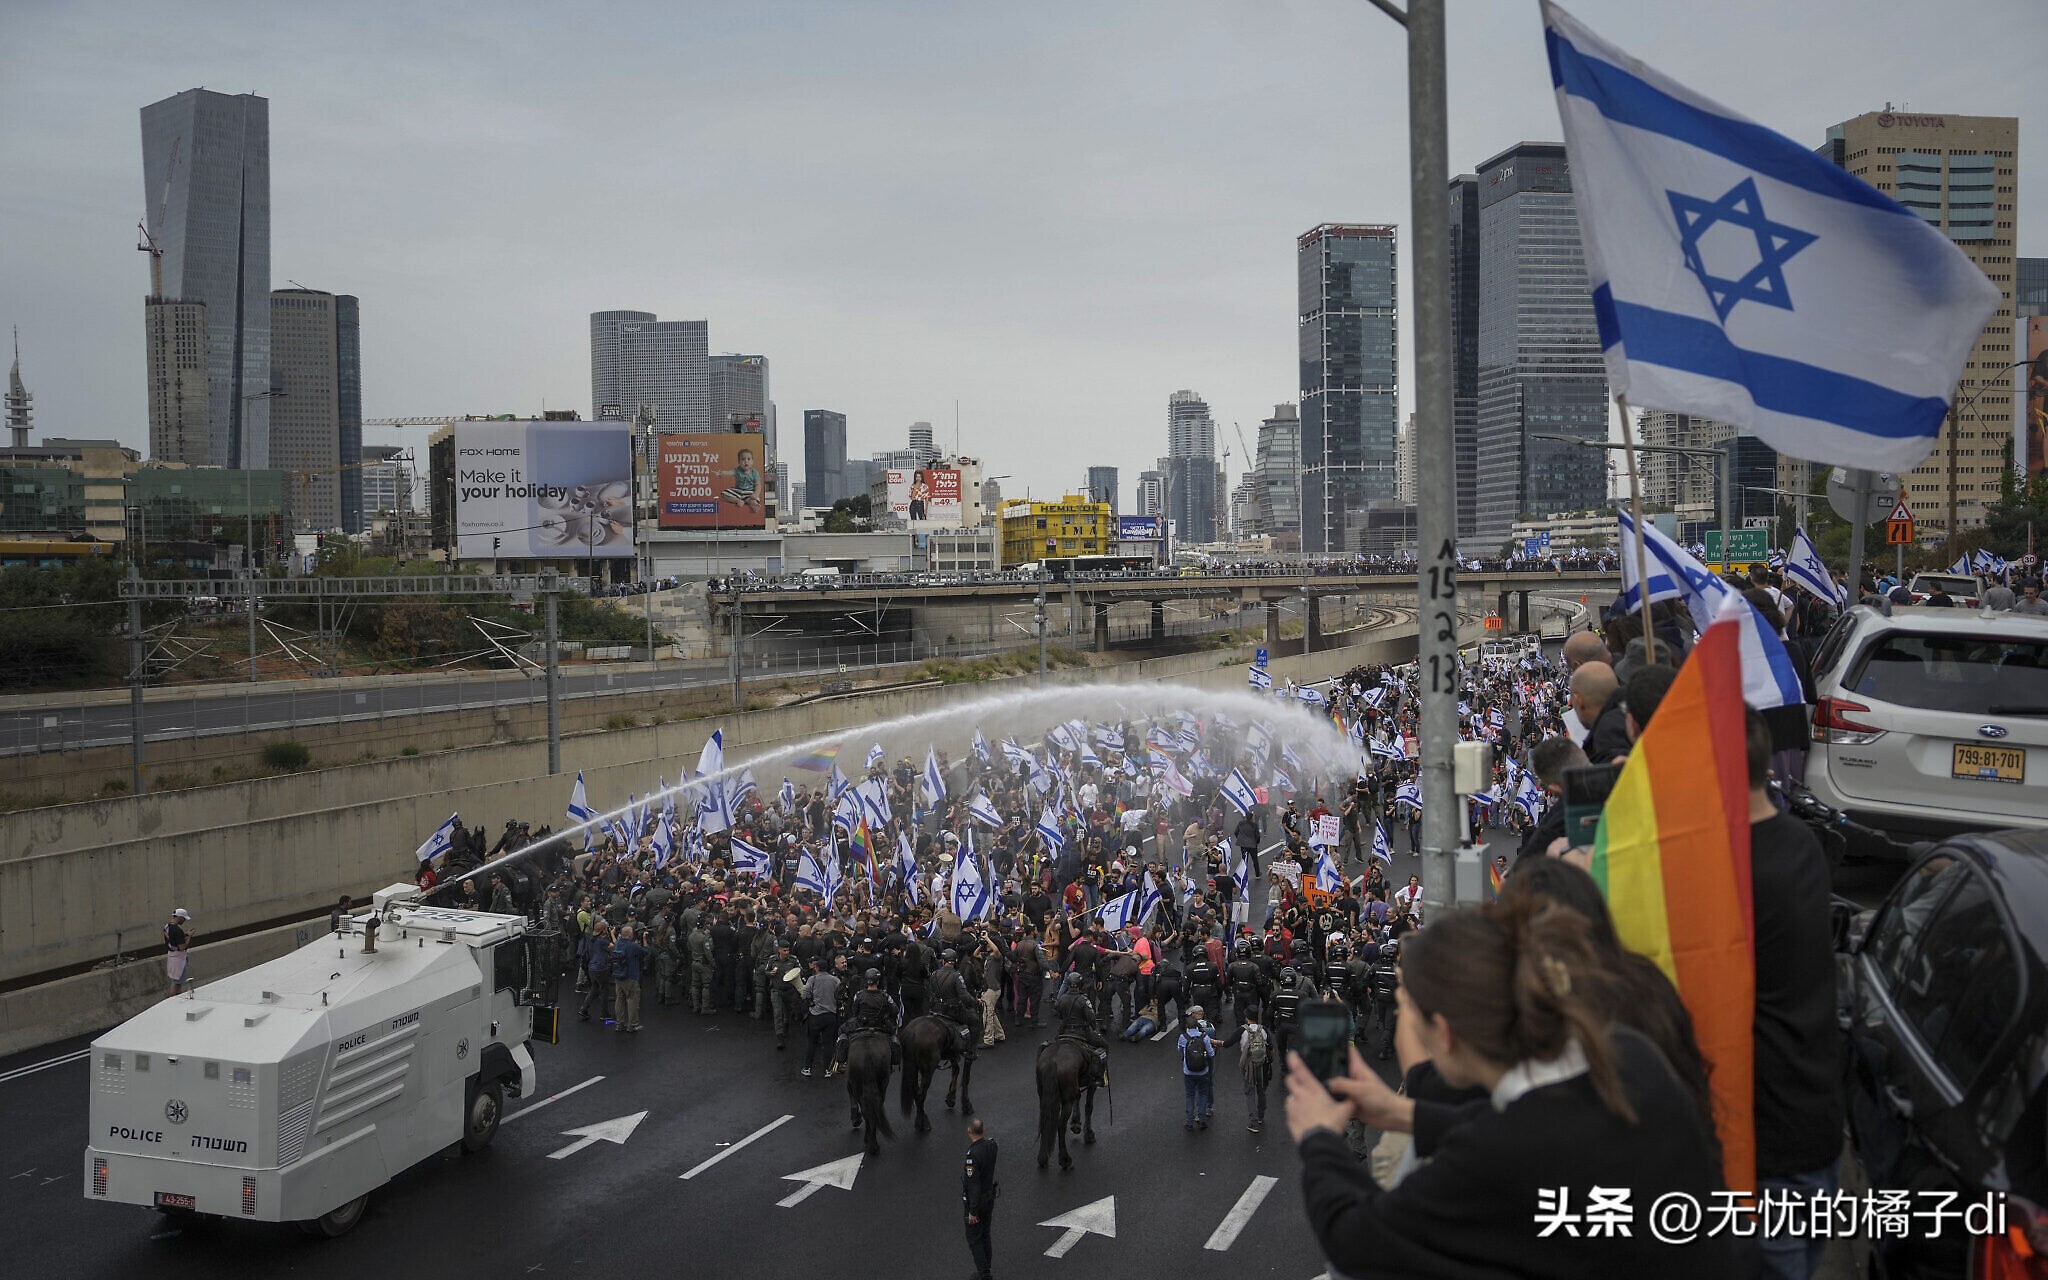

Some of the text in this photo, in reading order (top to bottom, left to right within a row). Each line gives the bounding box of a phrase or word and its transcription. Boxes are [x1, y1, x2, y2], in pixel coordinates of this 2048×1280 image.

[1896, 115, 1945, 128] TOYOTA
[665, 452, 719, 463] אל תמנעו
[460, 469, 521, 483] Make it
[674, 464, 710, 474] מהילד
[676, 474, 708, 485] שלכם
[461, 483, 567, 502] your holiday
[1428, 566, 1455, 599] 15
[1434, 612, 1456, 642] 2
[1429, 654, 1456, 695] 13
[392, 1012, 419, 1030] משטרה
[338, 1034, 366, 1052] POLICE
[110, 1126, 162, 1142] POLICE
[192, 1136, 247, 1152] משטרה
